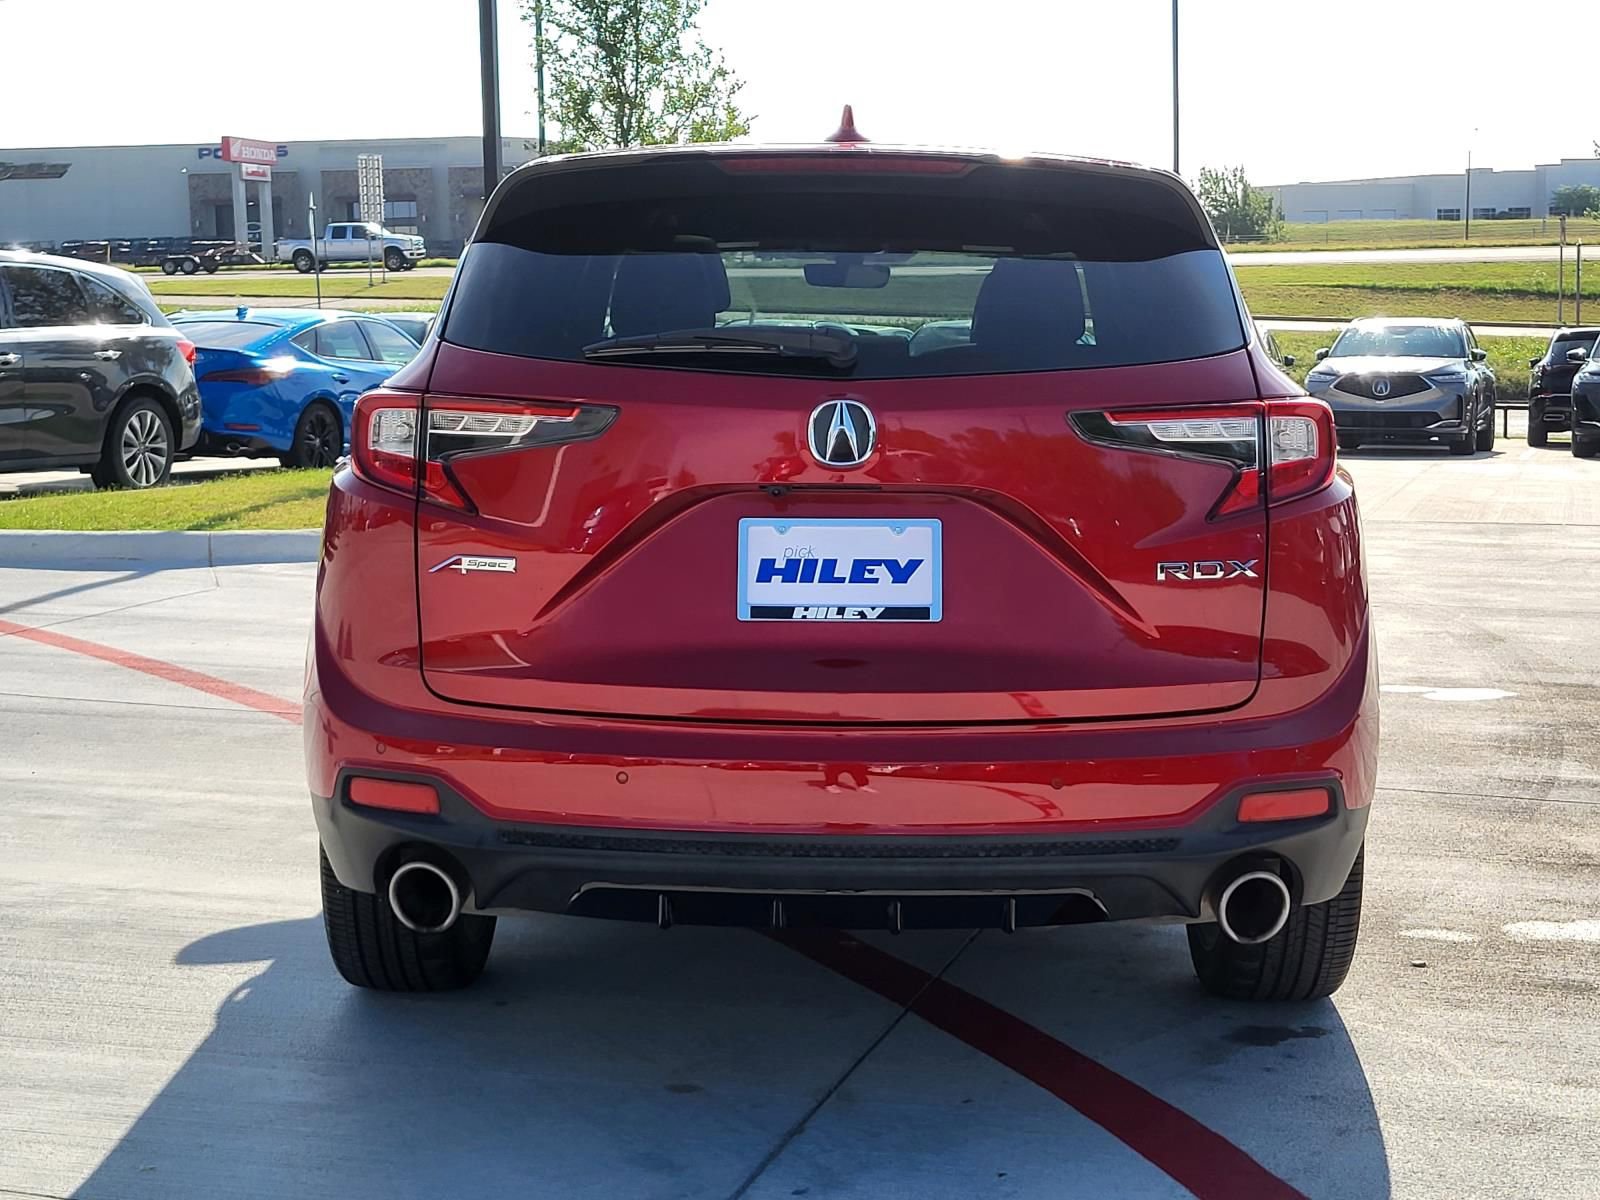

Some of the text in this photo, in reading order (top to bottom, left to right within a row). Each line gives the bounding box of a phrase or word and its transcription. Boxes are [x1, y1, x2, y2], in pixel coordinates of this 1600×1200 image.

[241, 146, 277, 161] HONDA
[783, 545, 815, 560] pick
[755, 558, 925, 584] HILEY
[1157, 559, 1259, 581] RDX
[792, 606, 886, 620] HILEY
